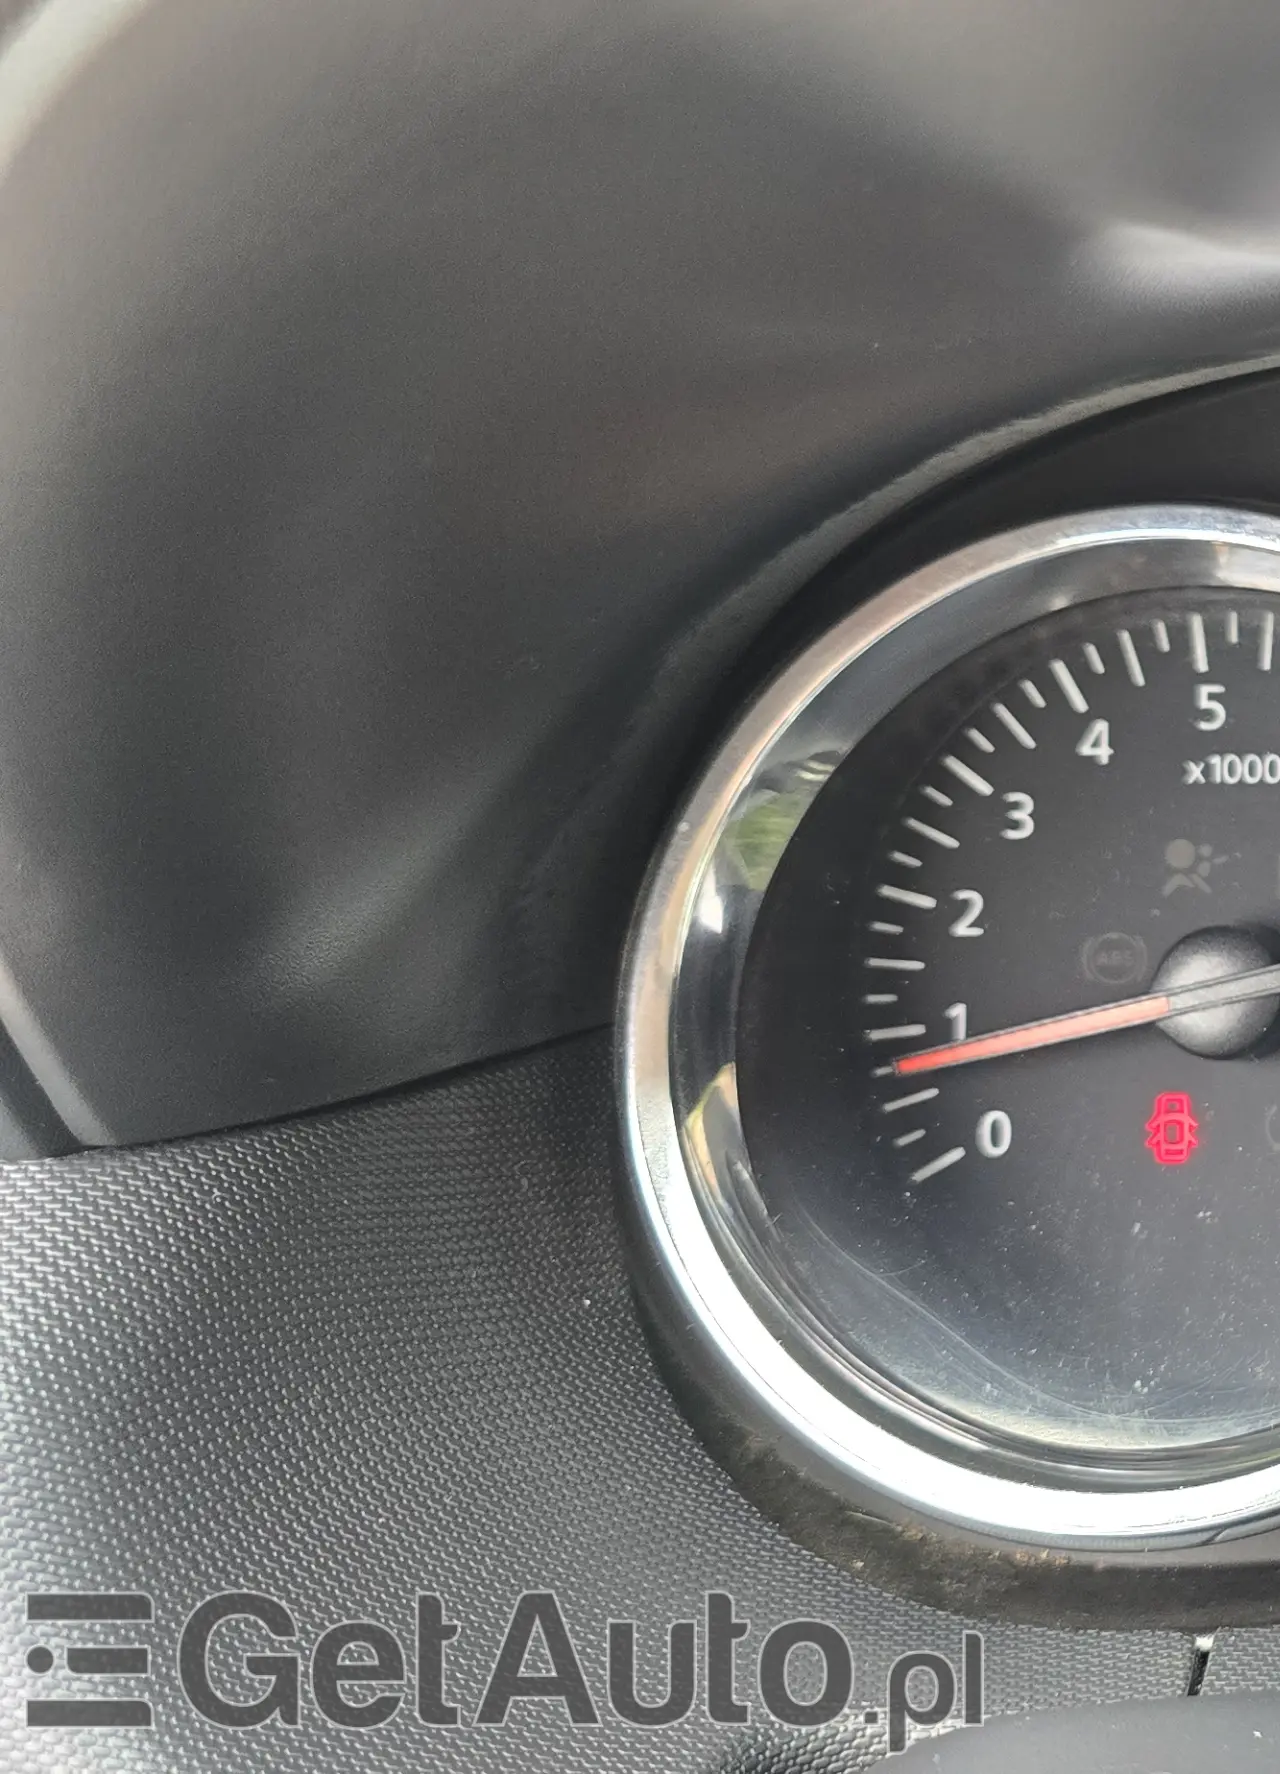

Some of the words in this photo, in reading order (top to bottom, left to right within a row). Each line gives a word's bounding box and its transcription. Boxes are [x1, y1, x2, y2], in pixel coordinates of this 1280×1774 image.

[1194, 684, 1227, 731] 5
[1076, 718, 1115, 765] 4
[1000, 791, 1035, 841] 3
[949, 889, 985, 938] 2
[944, 1002, 967, 1041] 1
[975, 1110, 1012, 1158] 0
